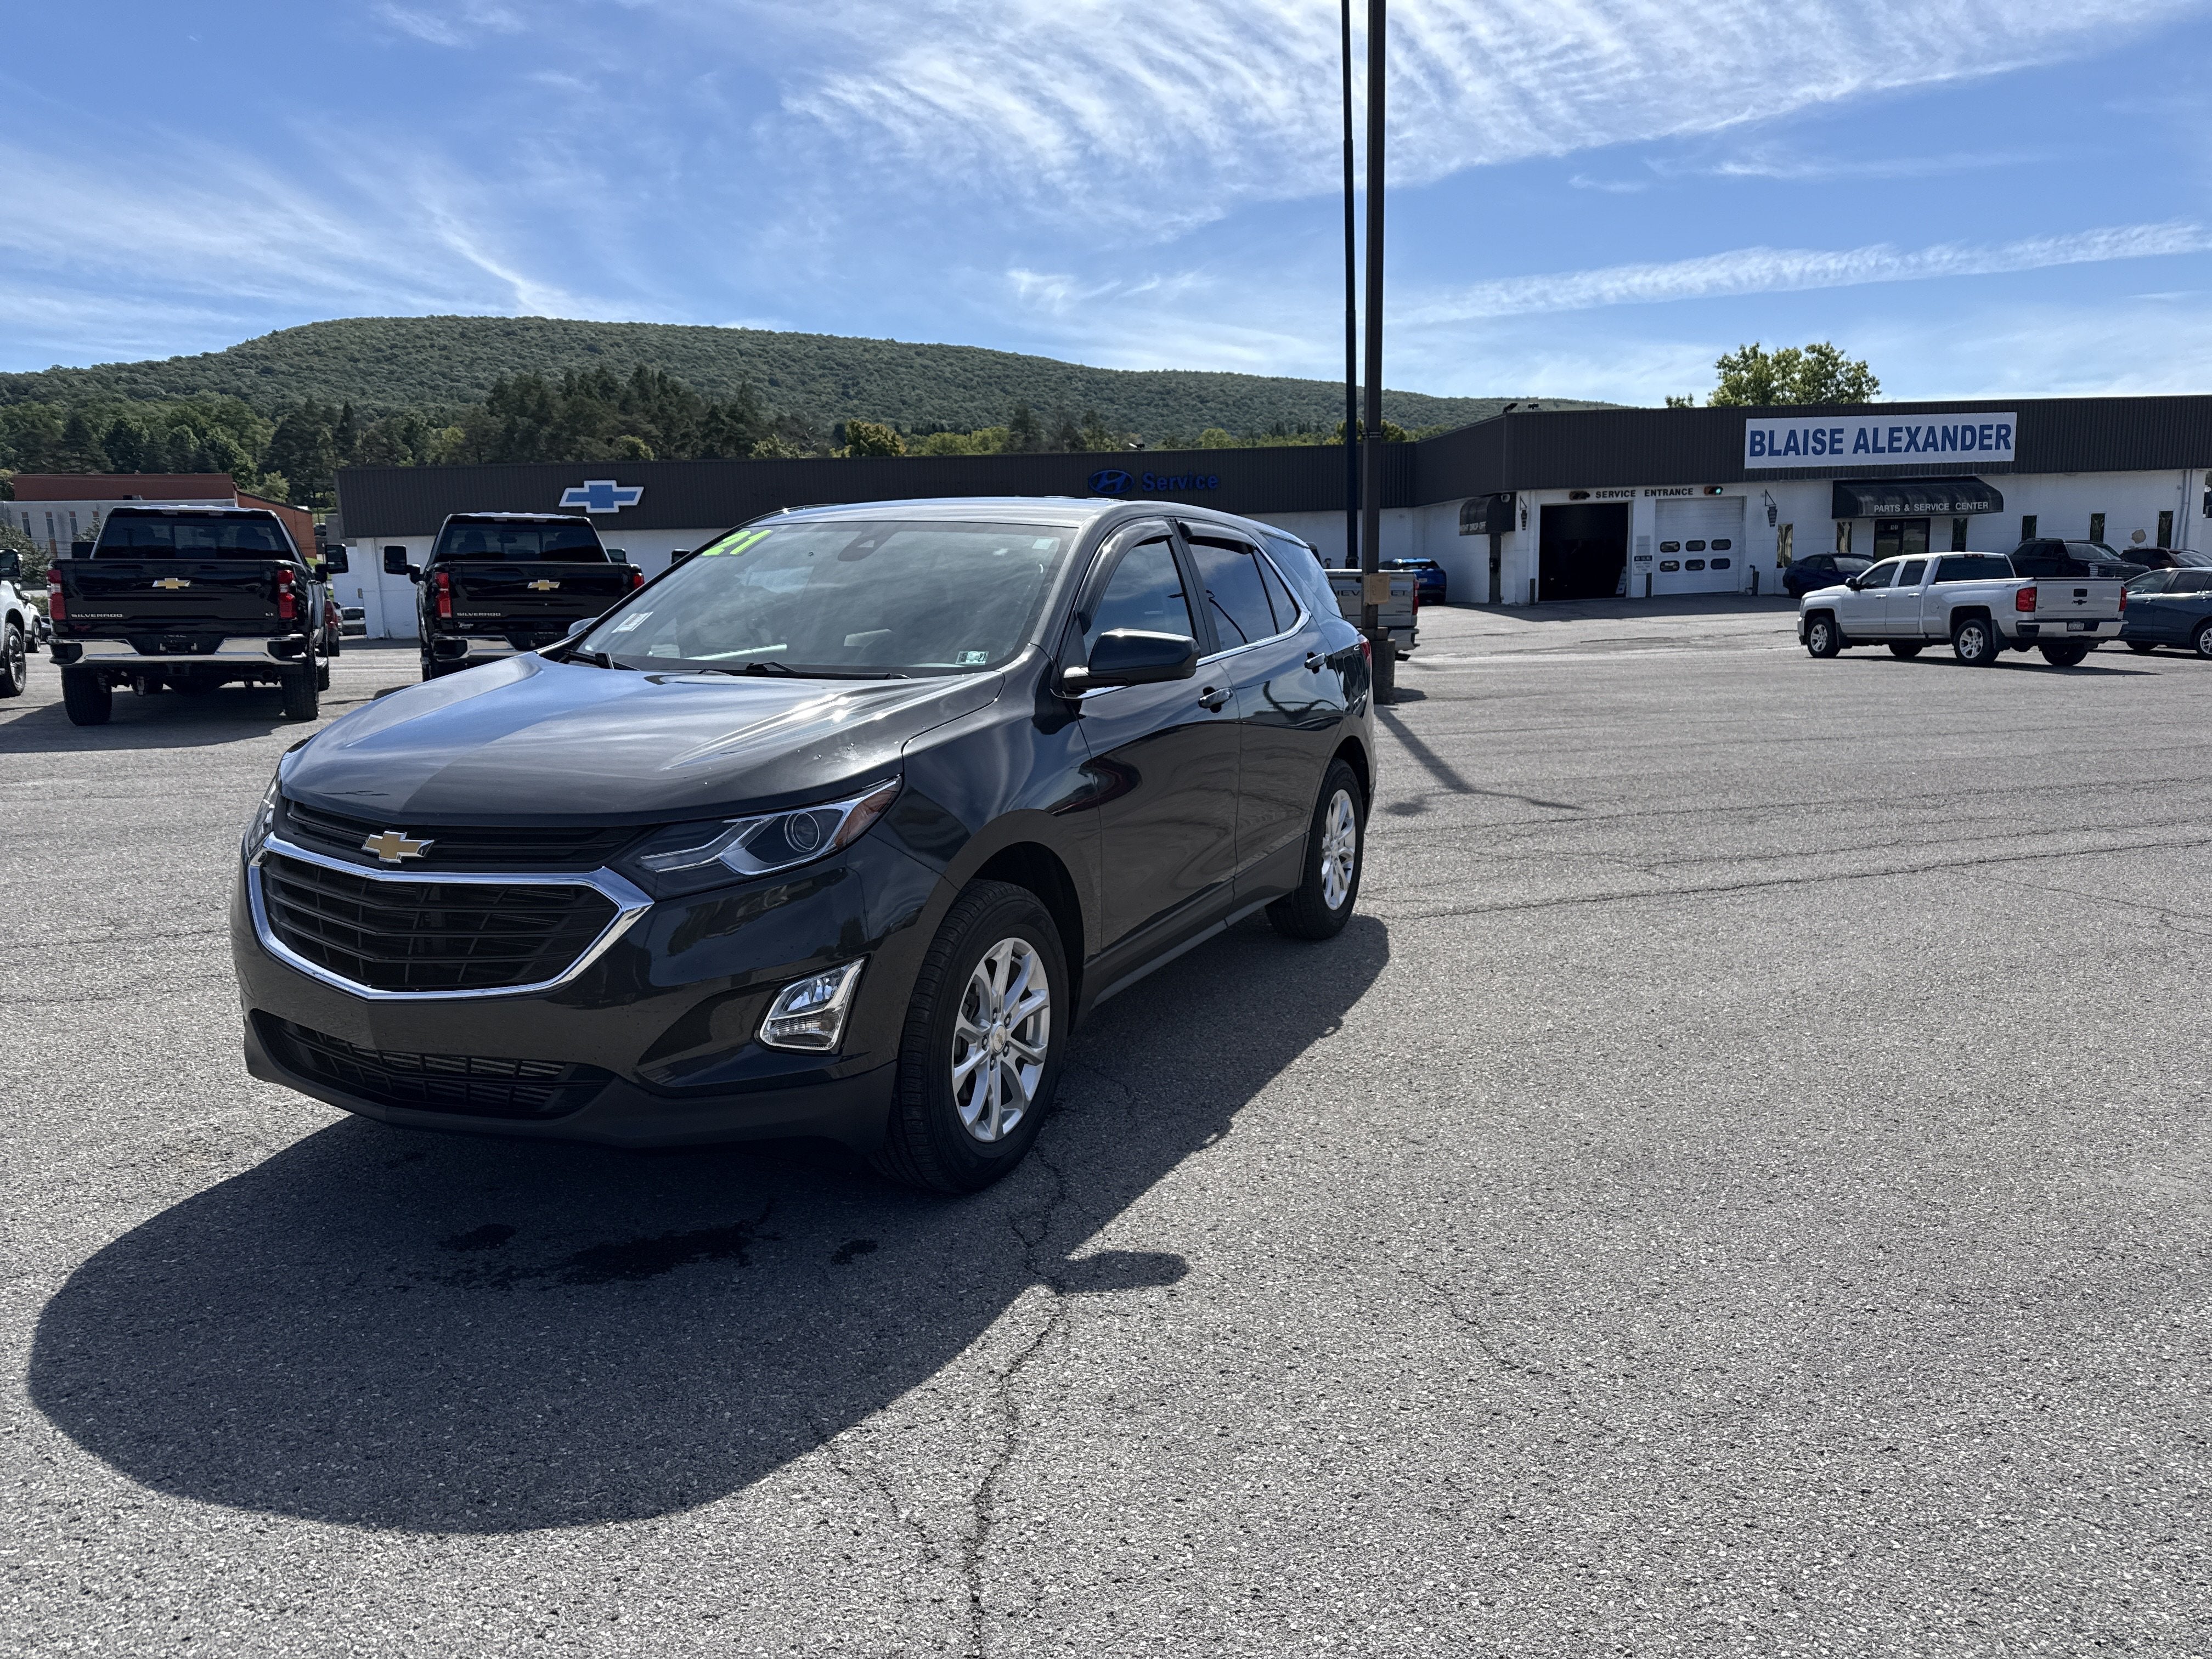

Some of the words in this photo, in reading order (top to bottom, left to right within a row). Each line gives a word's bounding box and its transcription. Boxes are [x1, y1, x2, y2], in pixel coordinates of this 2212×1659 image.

[1749, 428, 1844, 457] BLAISE
[1852, 424, 2012, 454] ALEXANDER
[1142, 471, 1219, 492] Service
[1595, 489, 1636, 499] SERVICE
[1644, 488, 1694, 497] ENTRANCE
[1874, 504, 1901, 513] PARTS
[1904, 504, 1910, 512] &
[1914, 503, 1950, 511] SERVICE
[1955, 501, 1989, 510] CENTER
[702, 529, 773, 556] 21
